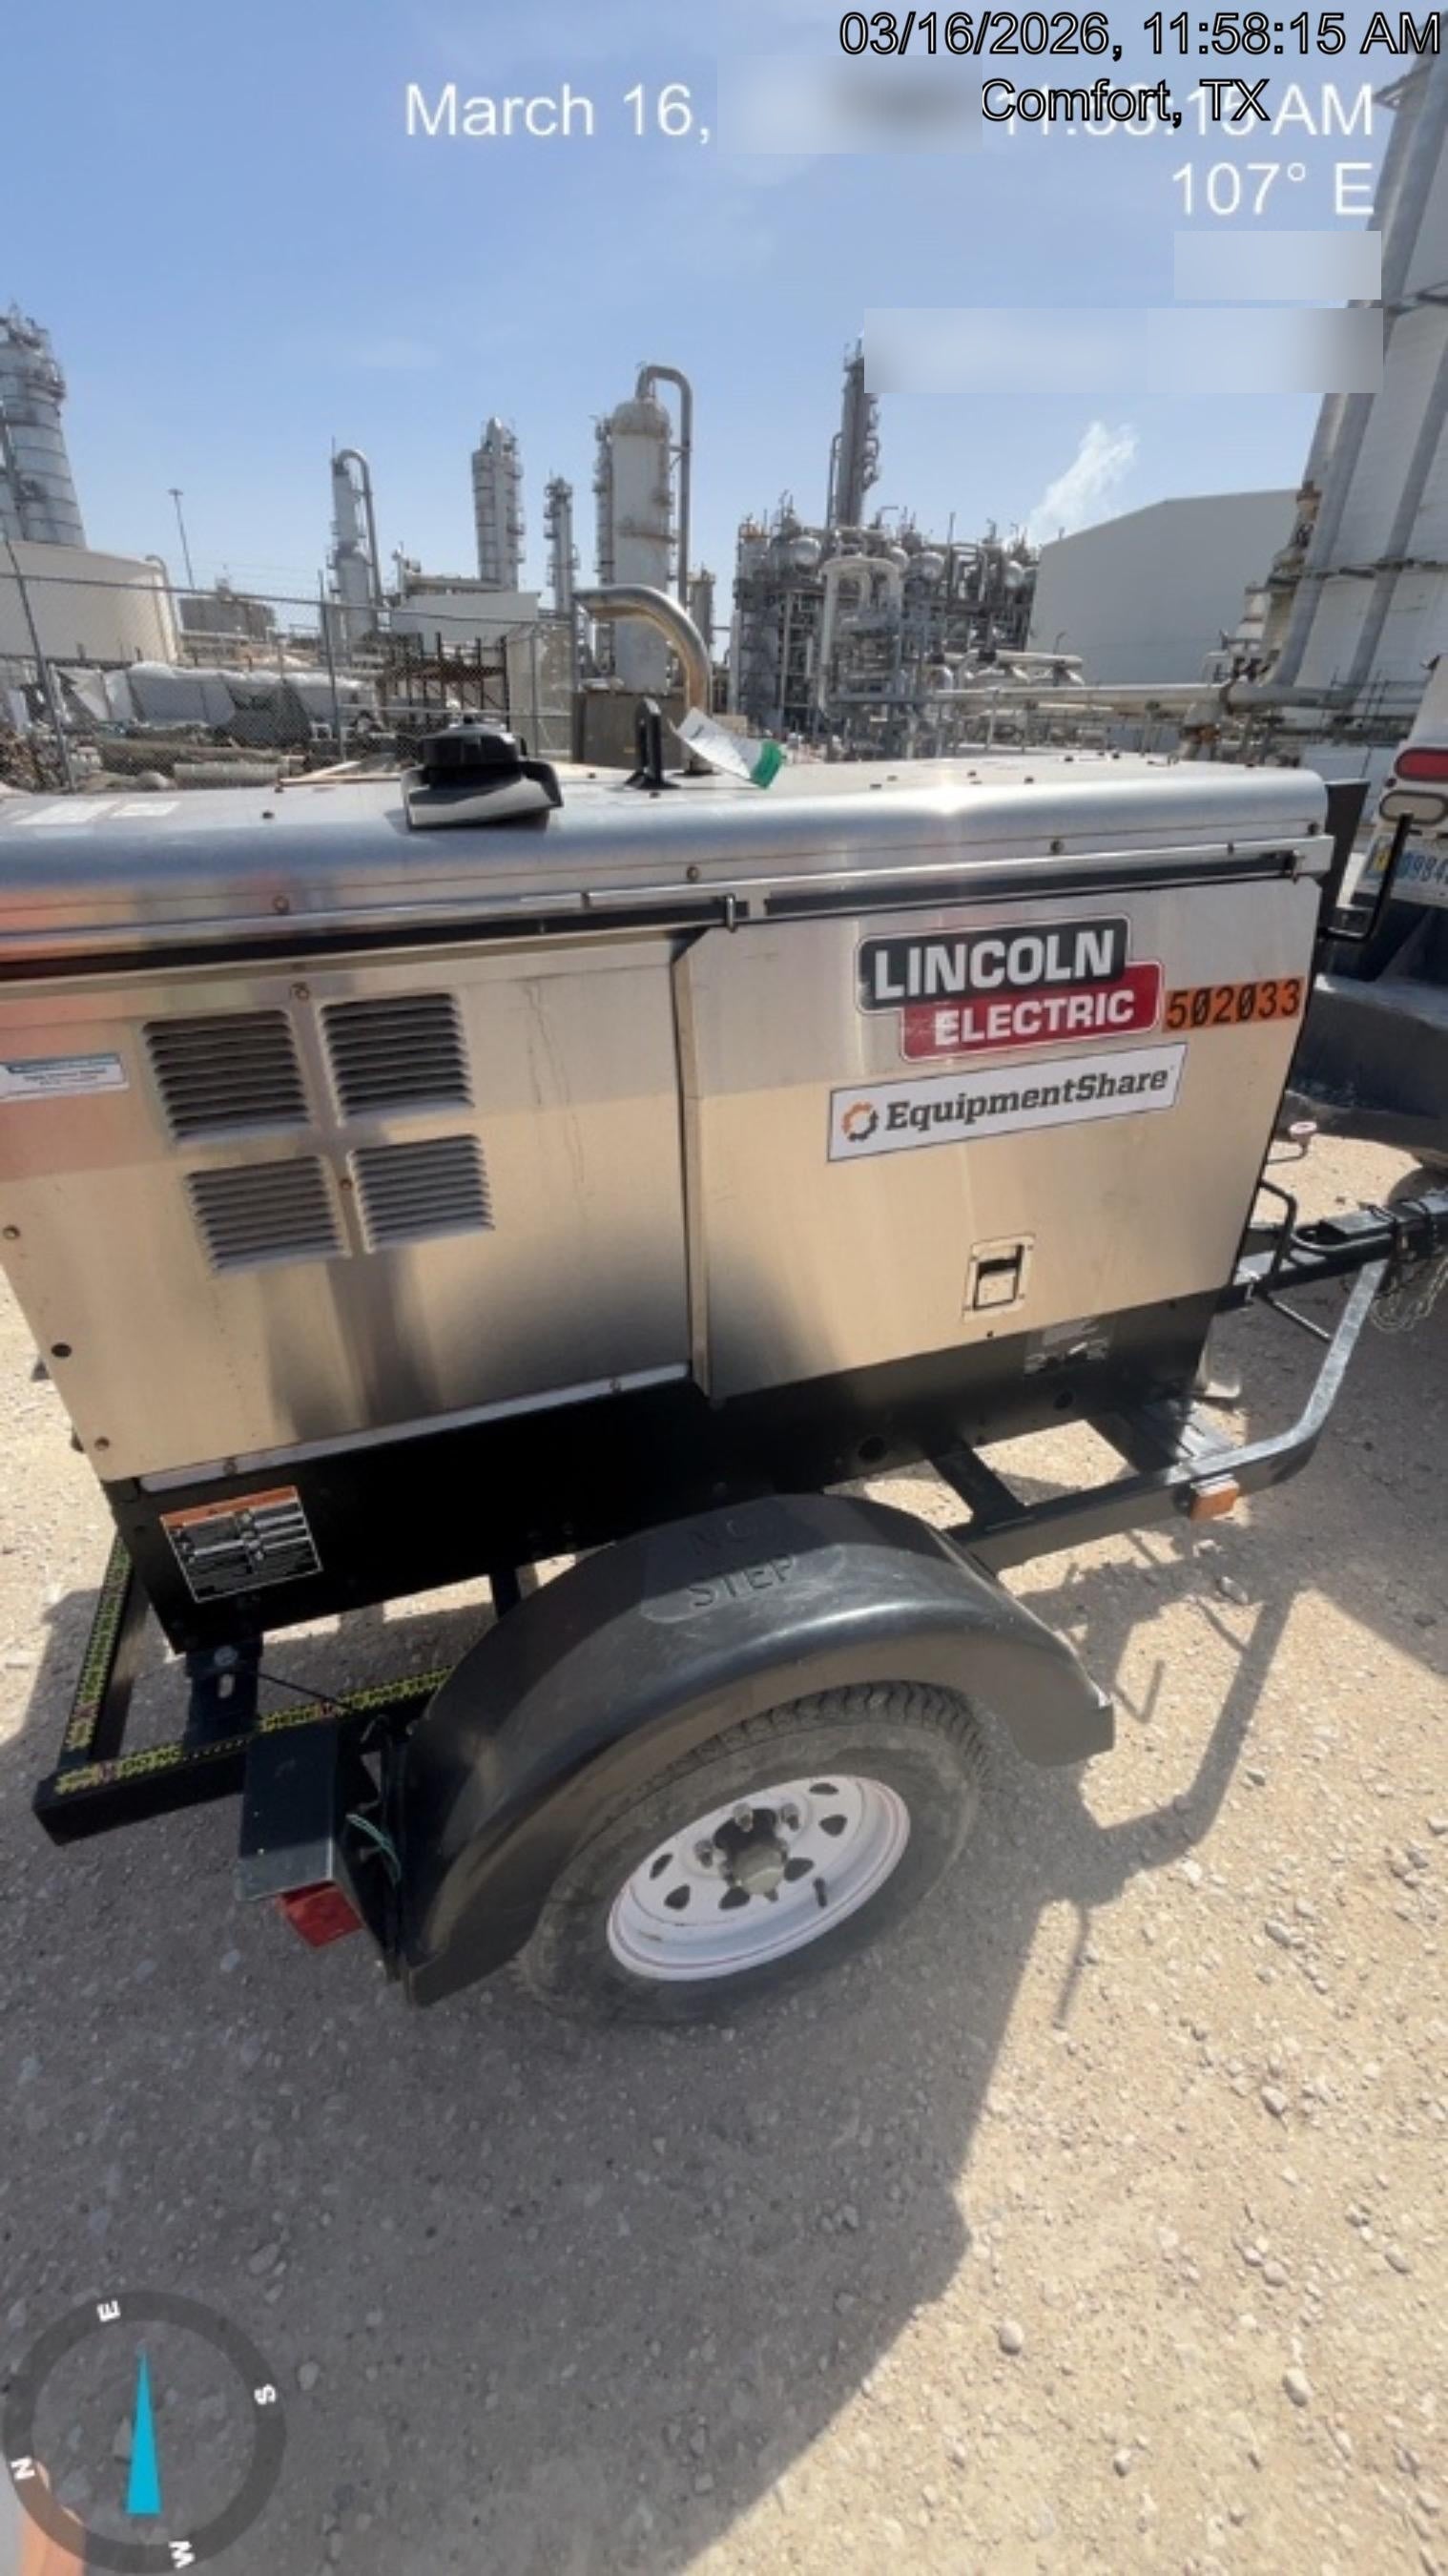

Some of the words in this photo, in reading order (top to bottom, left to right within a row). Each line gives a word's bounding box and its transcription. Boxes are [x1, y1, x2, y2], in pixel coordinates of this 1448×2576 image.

[874, 927, 1115, 1000] LINCOLN
[934, 988, 1136, 1047] ELECTRIC
[1166, 978, 1301, 1028] 502033
[885, 1067, 1169, 1132] EquipmentShare
[686, 1554, 796, 1607] STEP
